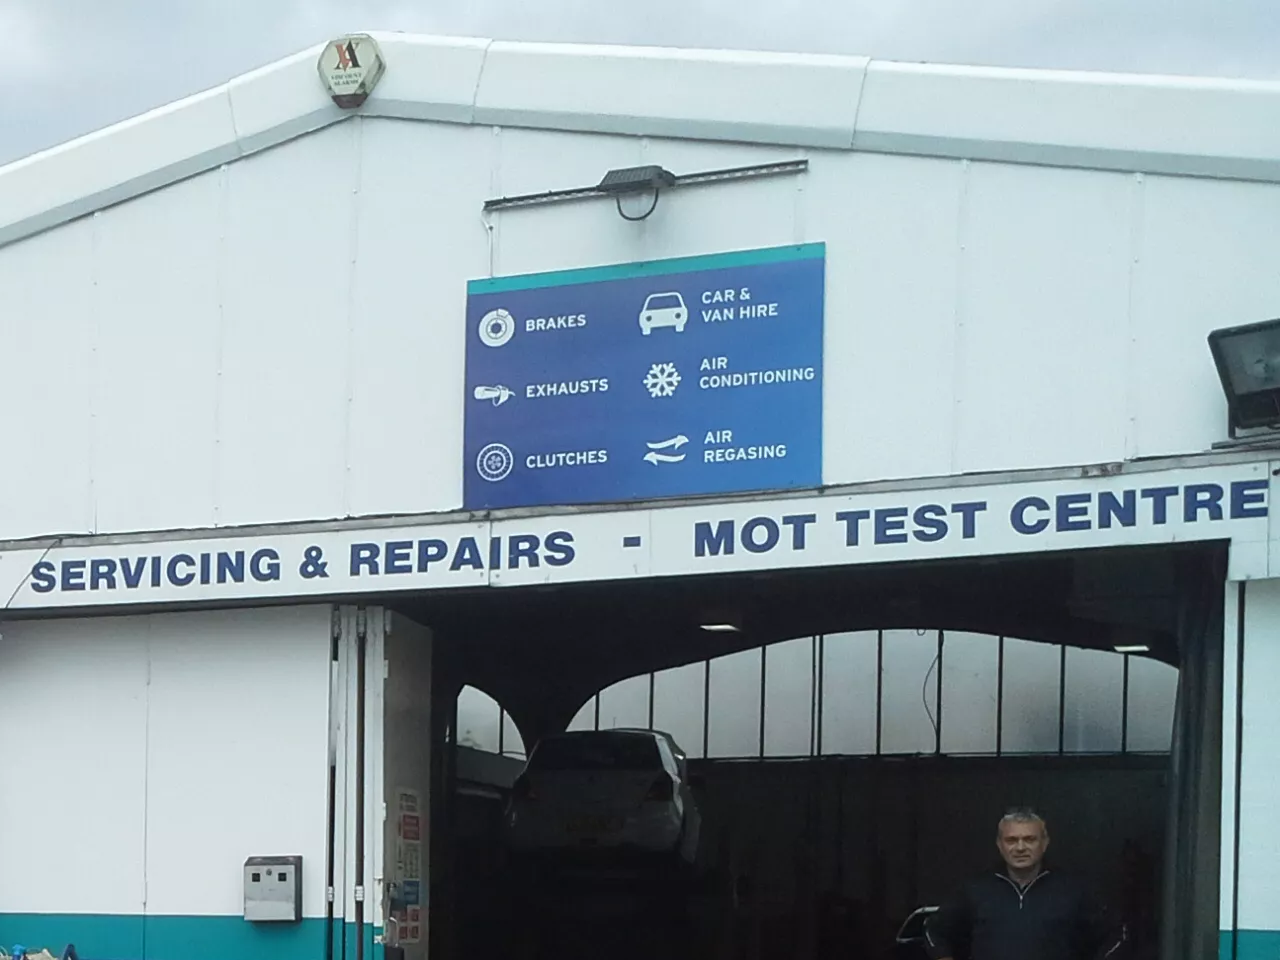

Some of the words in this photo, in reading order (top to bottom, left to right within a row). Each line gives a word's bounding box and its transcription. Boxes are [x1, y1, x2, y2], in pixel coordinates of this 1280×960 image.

[702, 289, 735, 304] CAR
[739, 287, 750, 301] &
[702, 307, 734, 323] VAN
[739, 303, 778, 319] HIRE
[525, 314, 587, 332] BRAKES
[700, 357, 728, 371] AIR
[699, 368, 815, 389] CONDITIONING
[526, 379, 608, 398] EXHAUSTS
[704, 430, 732, 445] AIR
[526, 450, 608, 469] CLUTCHES
[704, 445, 787, 463] REGASING
[29, 546, 281, 593] SERVICING
[299, 546, 329, 579] &
[350, 531, 576, 577] REPAIRS
[694, 513, 816, 558] MOT
[836, 501, 988, 547] TEST
[1010, 479, 1269, 535] CENTRE
